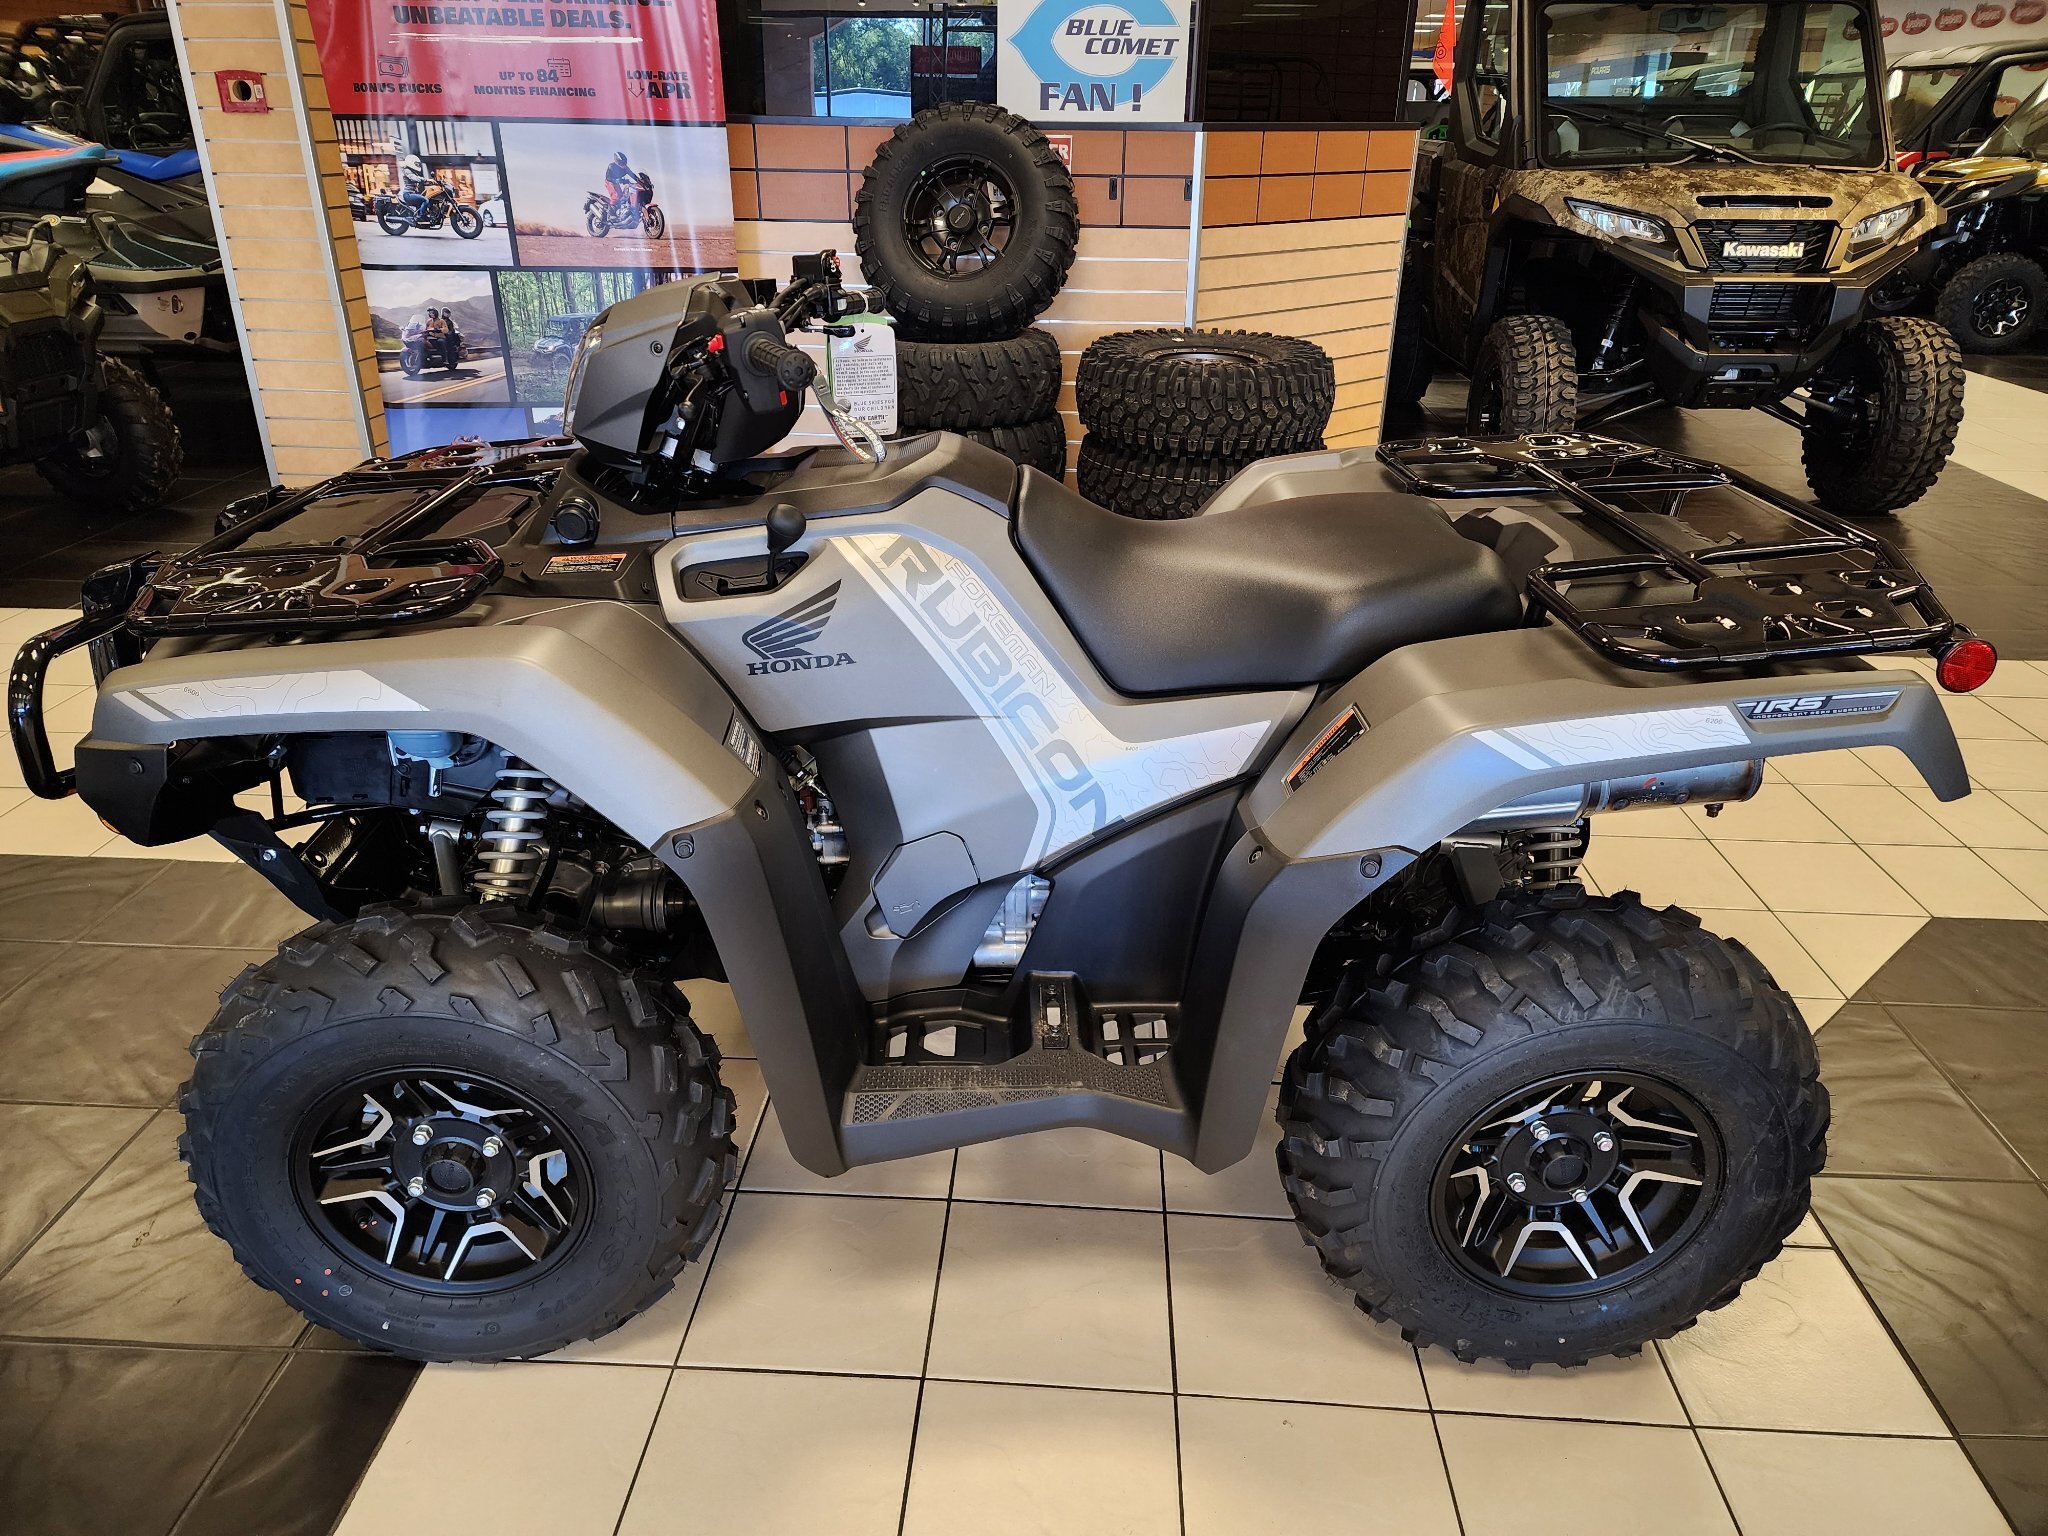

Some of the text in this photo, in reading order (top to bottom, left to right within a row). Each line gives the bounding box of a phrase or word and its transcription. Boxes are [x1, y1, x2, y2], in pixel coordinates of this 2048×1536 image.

[393, 6, 632, 29] UNBEATABLE DEALS.
[1065, 19, 1135, 36] BLUE
[1084, 38, 1180, 55] COMET
[499, 68, 559, 83] UP TO 84
[626, 69, 689, 81] LOW-RATE
[353, 82, 443, 95] BONUS BUCKS
[474, 85, 597, 98] MONTHS FINANCING
[646, 81, 692, 99] APR
[1039, 82, 1116, 112] FAN
[1722, 241, 1805, 259] Kawasaki
[945, 556, 1057, 698] FOREMAN
[746, 652, 857, 676] HONDA
[879, 535, 1124, 837] RUBICON
[1752, 696, 1827, 714] IRS
[1752, 711, 1809, 719] INDEPENDENT
[1832, 705, 1882, 714] SUSPENSION
[1308, 725, 1339, 758] WARNING
